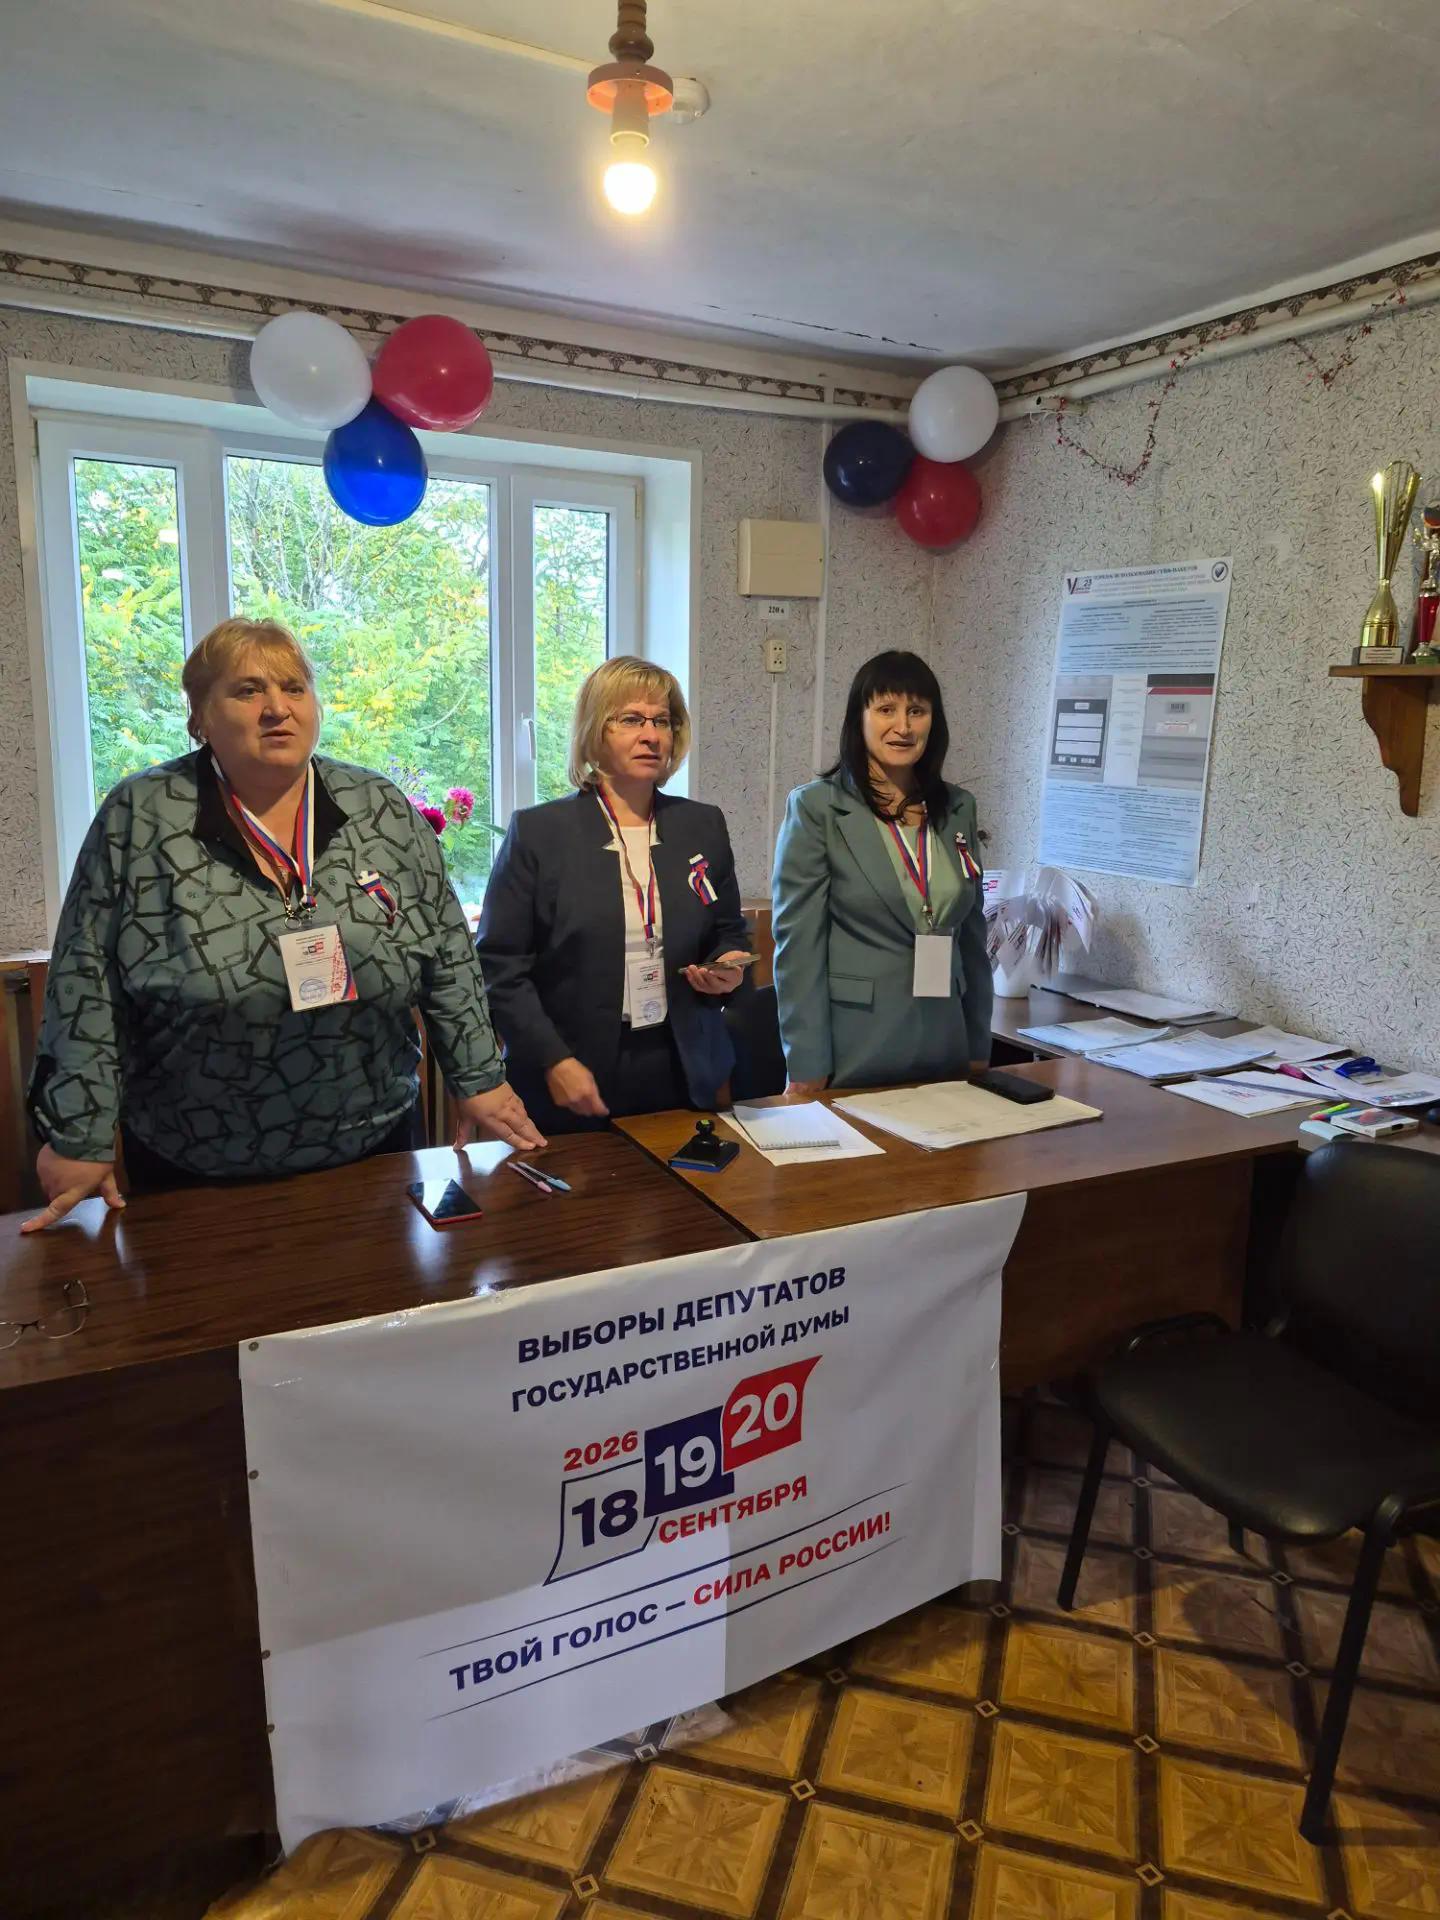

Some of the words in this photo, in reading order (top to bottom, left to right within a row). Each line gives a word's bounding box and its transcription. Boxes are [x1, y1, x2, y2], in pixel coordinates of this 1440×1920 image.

[512, 1325, 775, 1412] ГОСУДАРСТВЕННОЙ
[781, 1306, 849, 1346] ДУМЫ
[519, 1308, 664, 1363] ВЫБОРЫ
[673, 1267, 845, 1329] ДЕПУТАТОВ
[565, 1432, 637, 1470] 2026
[572, 1490, 638, 1547] 18
[655, 1436, 715, 1494] 19
[731, 1383, 797, 1448] 20
[659, 1477, 807, 1544] СЕНТЯБРЯ
[449, 1637, 542, 1691] ТВОЙ
[553, 1604, 657, 1656] ГОЛОС
[693, 1564, 769, 1605] СИЛА
[780, 1513, 890, 1574] РОССИИ!
